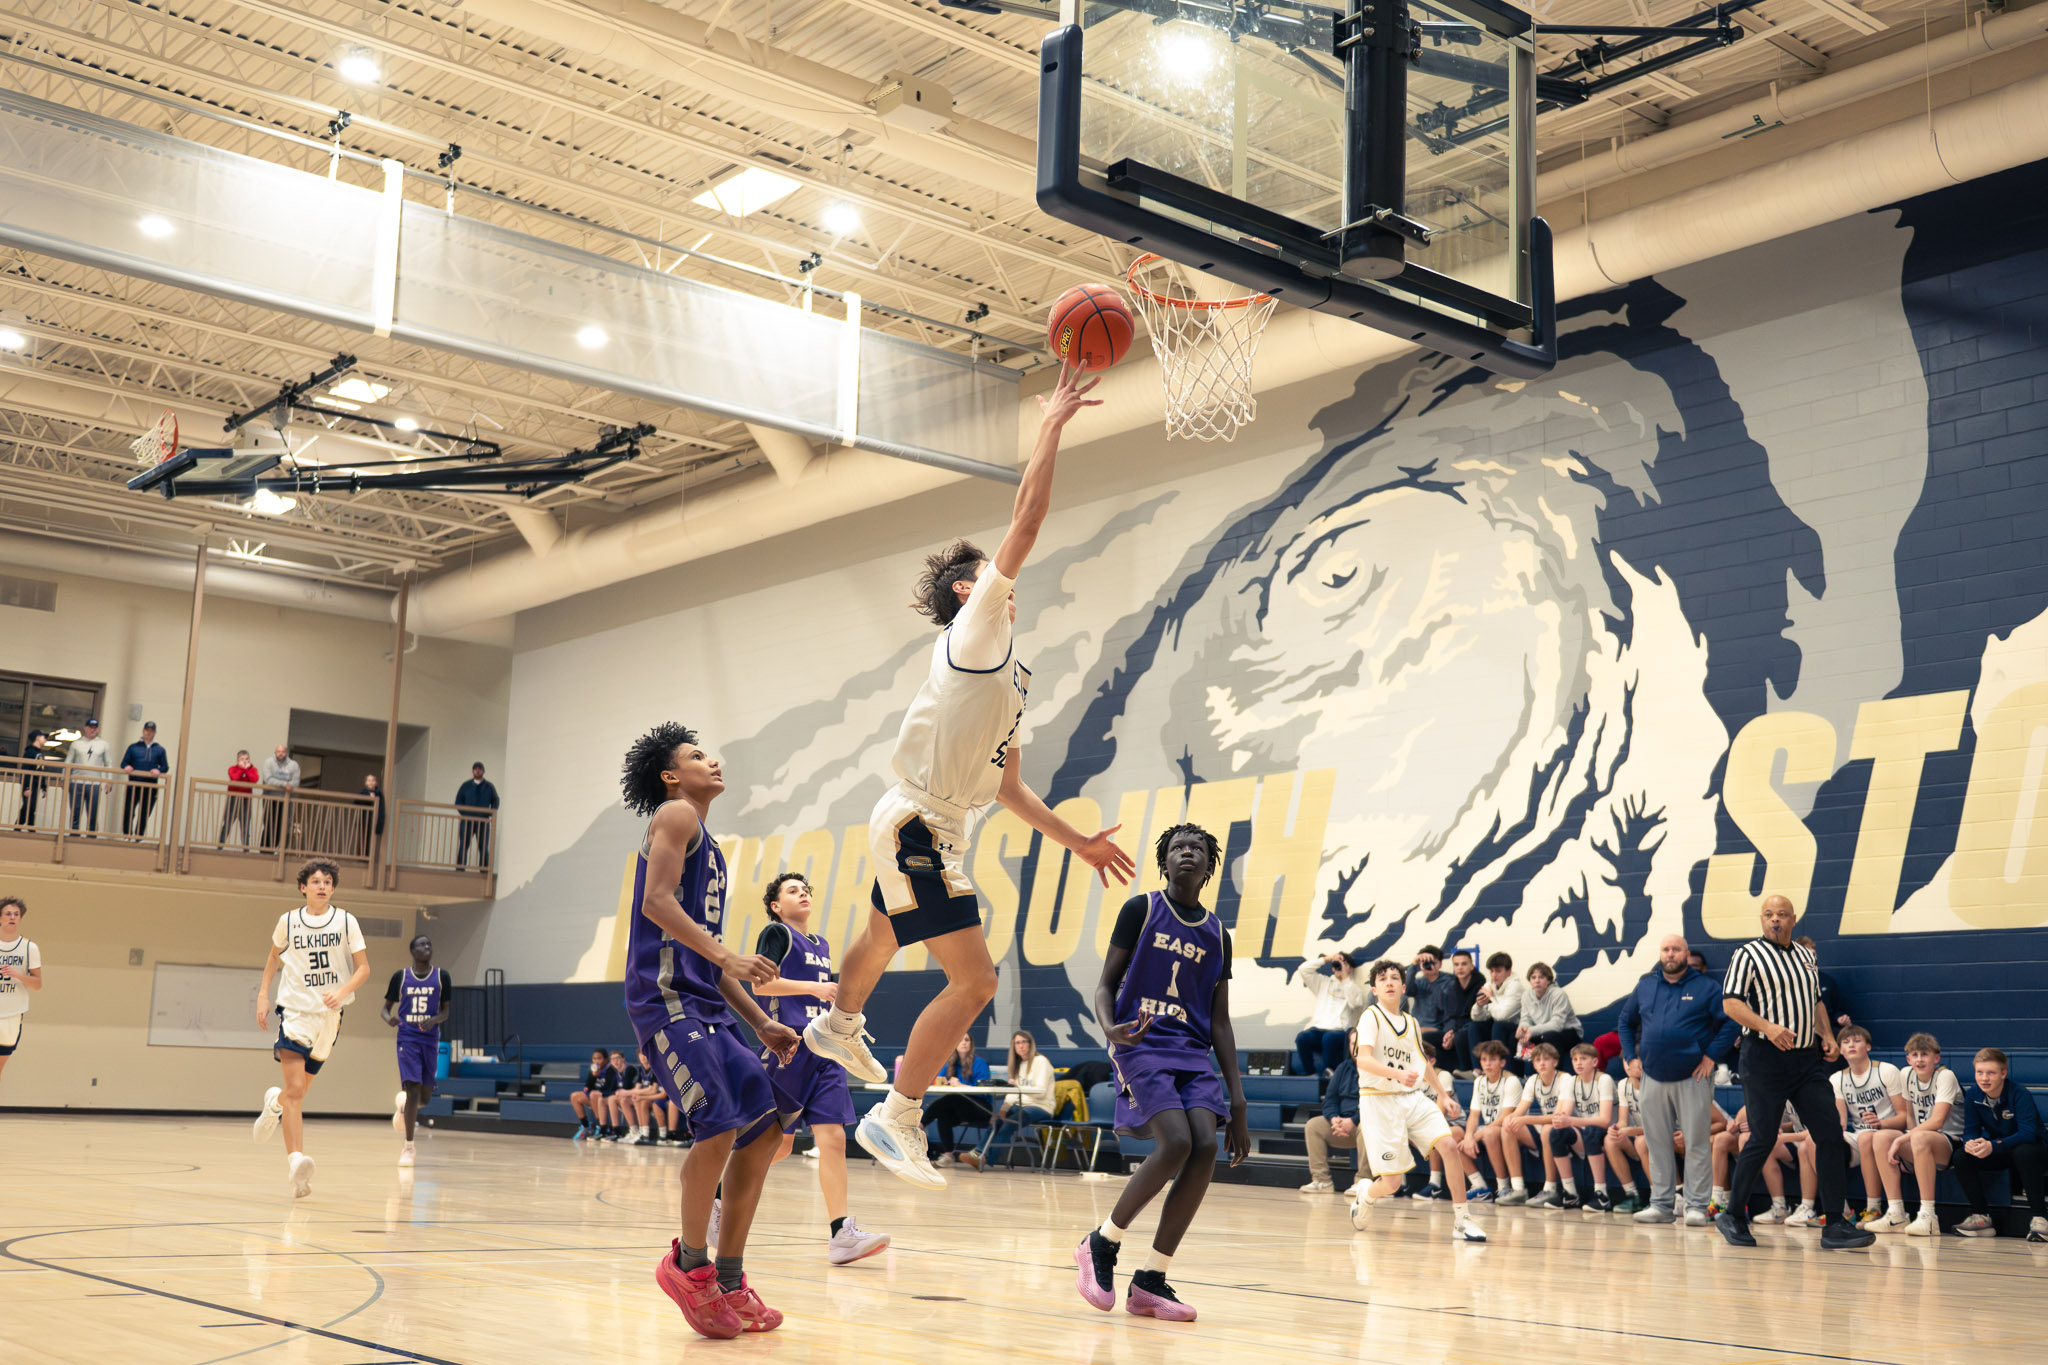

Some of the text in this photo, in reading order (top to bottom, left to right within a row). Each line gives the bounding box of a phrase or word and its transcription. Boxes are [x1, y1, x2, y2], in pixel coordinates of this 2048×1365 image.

[973, 768, 1338, 966] SOUTH
[293, 932, 342, 950] ELKHORN
[1153, 932, 1207, 964] EAST
[308, 951, 330, 970] 30
[304, 971, 338, 987] SOUTH
[1166, 960, 1181, 998] 1
[406, 986, 435, 995] EAST
[411, 996, 429, 1014] 15
